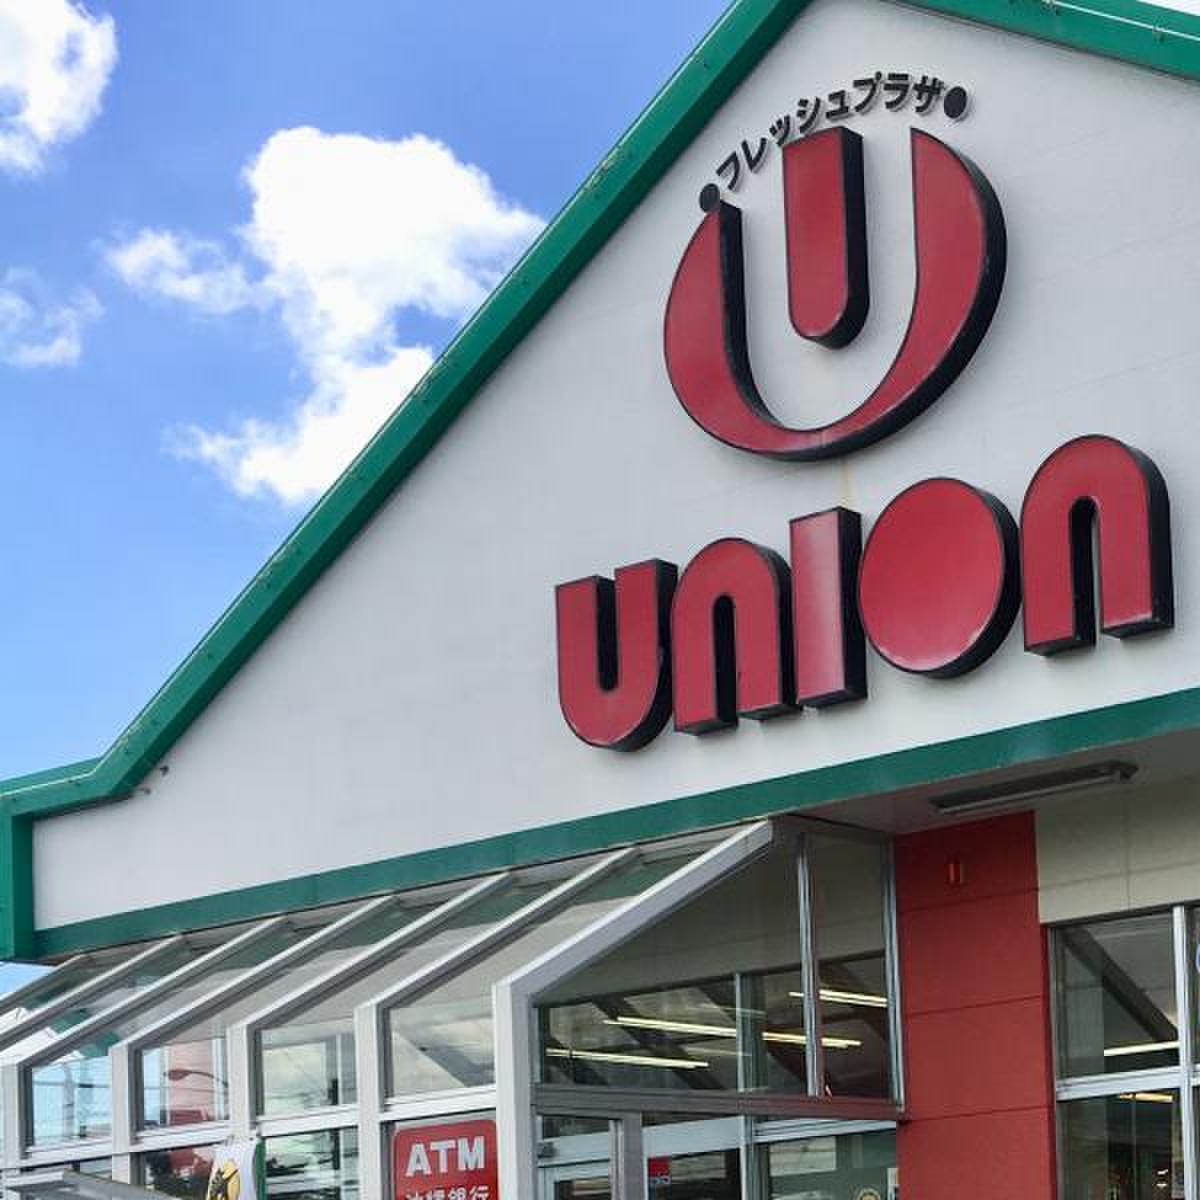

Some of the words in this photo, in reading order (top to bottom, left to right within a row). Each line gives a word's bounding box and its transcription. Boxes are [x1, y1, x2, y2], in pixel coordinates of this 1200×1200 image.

[715, 71, 945, 190] フレッシュプラザ
[405, 1136, 485, 1176] ATM
